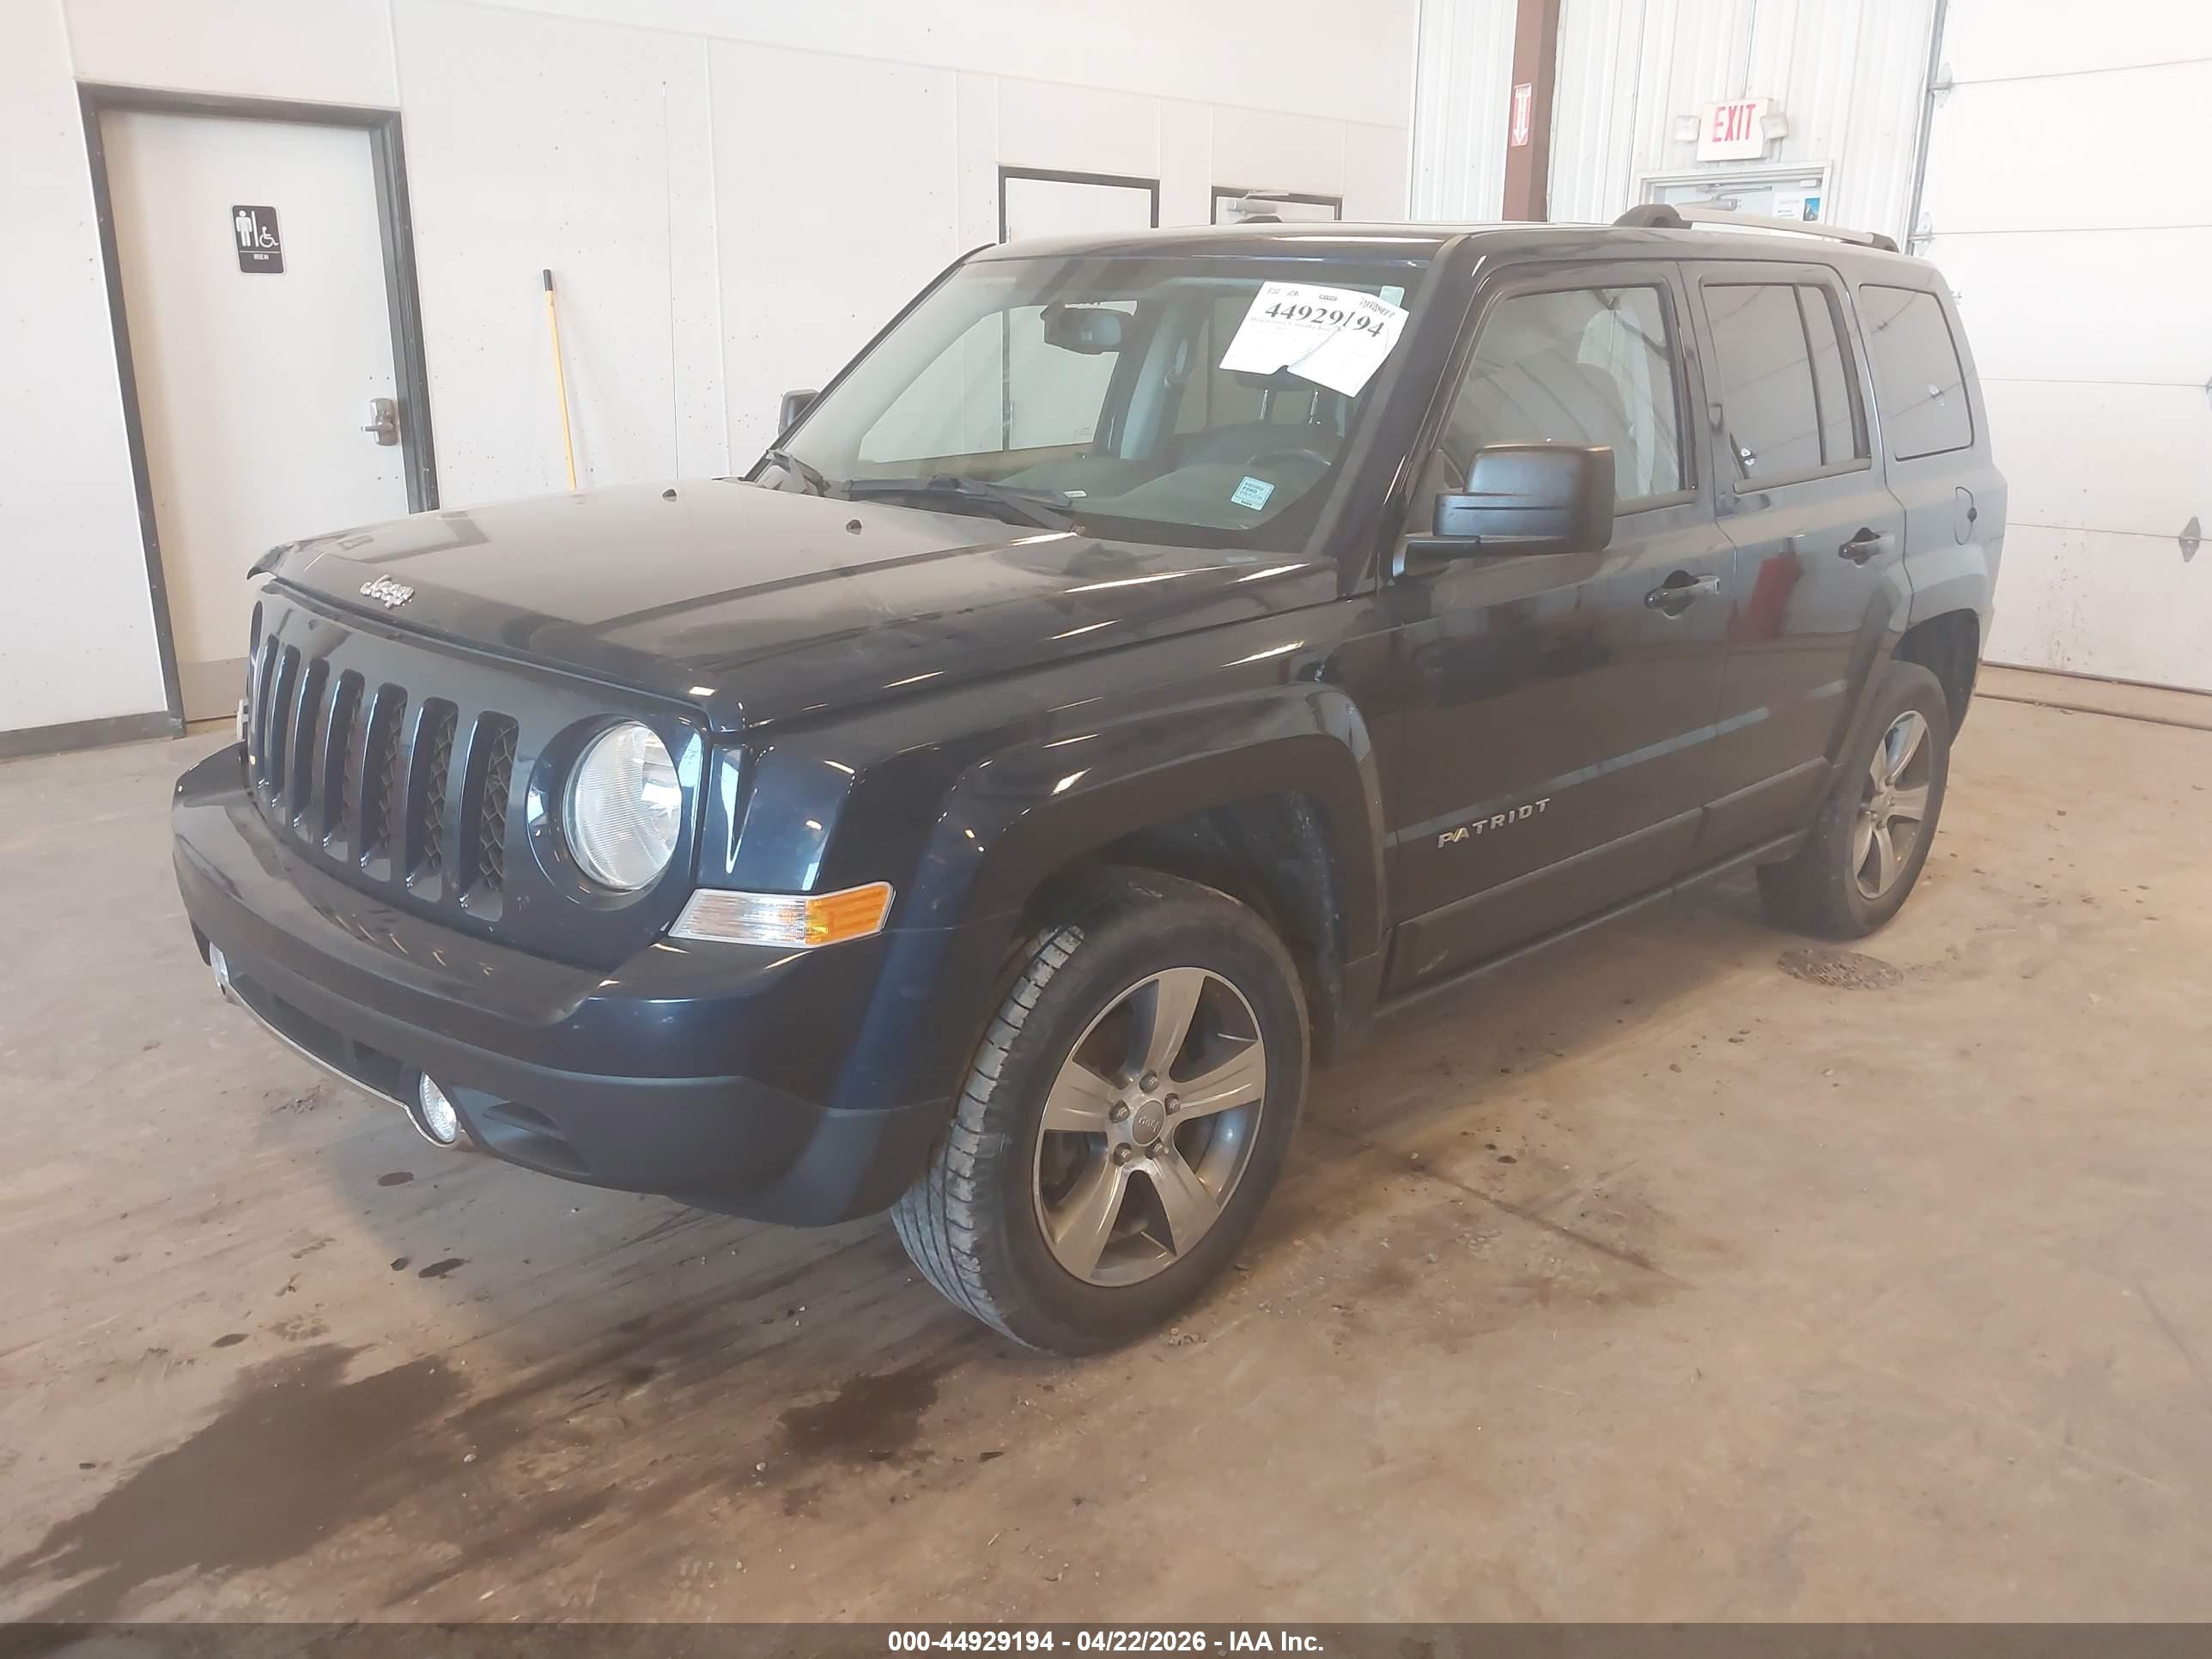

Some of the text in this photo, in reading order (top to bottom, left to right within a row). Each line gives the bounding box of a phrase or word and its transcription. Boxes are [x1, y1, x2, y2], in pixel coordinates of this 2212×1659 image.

[1712, 103, 1757, 143] EXIT
[360, 574, 415, 609] Jeep
[1437, 798, 1551, 848] PATRIOT
